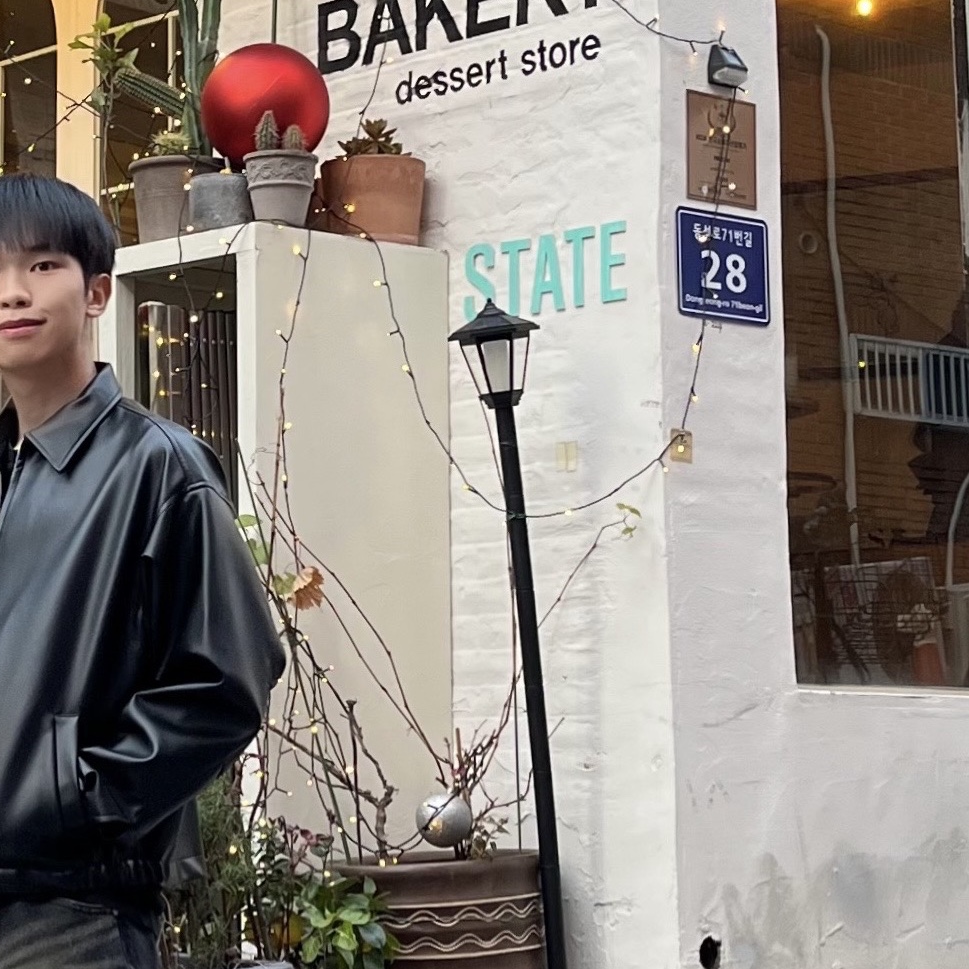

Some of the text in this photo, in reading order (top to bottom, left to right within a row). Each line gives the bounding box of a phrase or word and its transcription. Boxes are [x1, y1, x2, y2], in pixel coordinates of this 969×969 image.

[318, 0, 597, 74] BAKE
[395, 34, 601, 105] dessert store
[464, 220, 628, 322] STATE
[700, 249, 748, 294] 28
